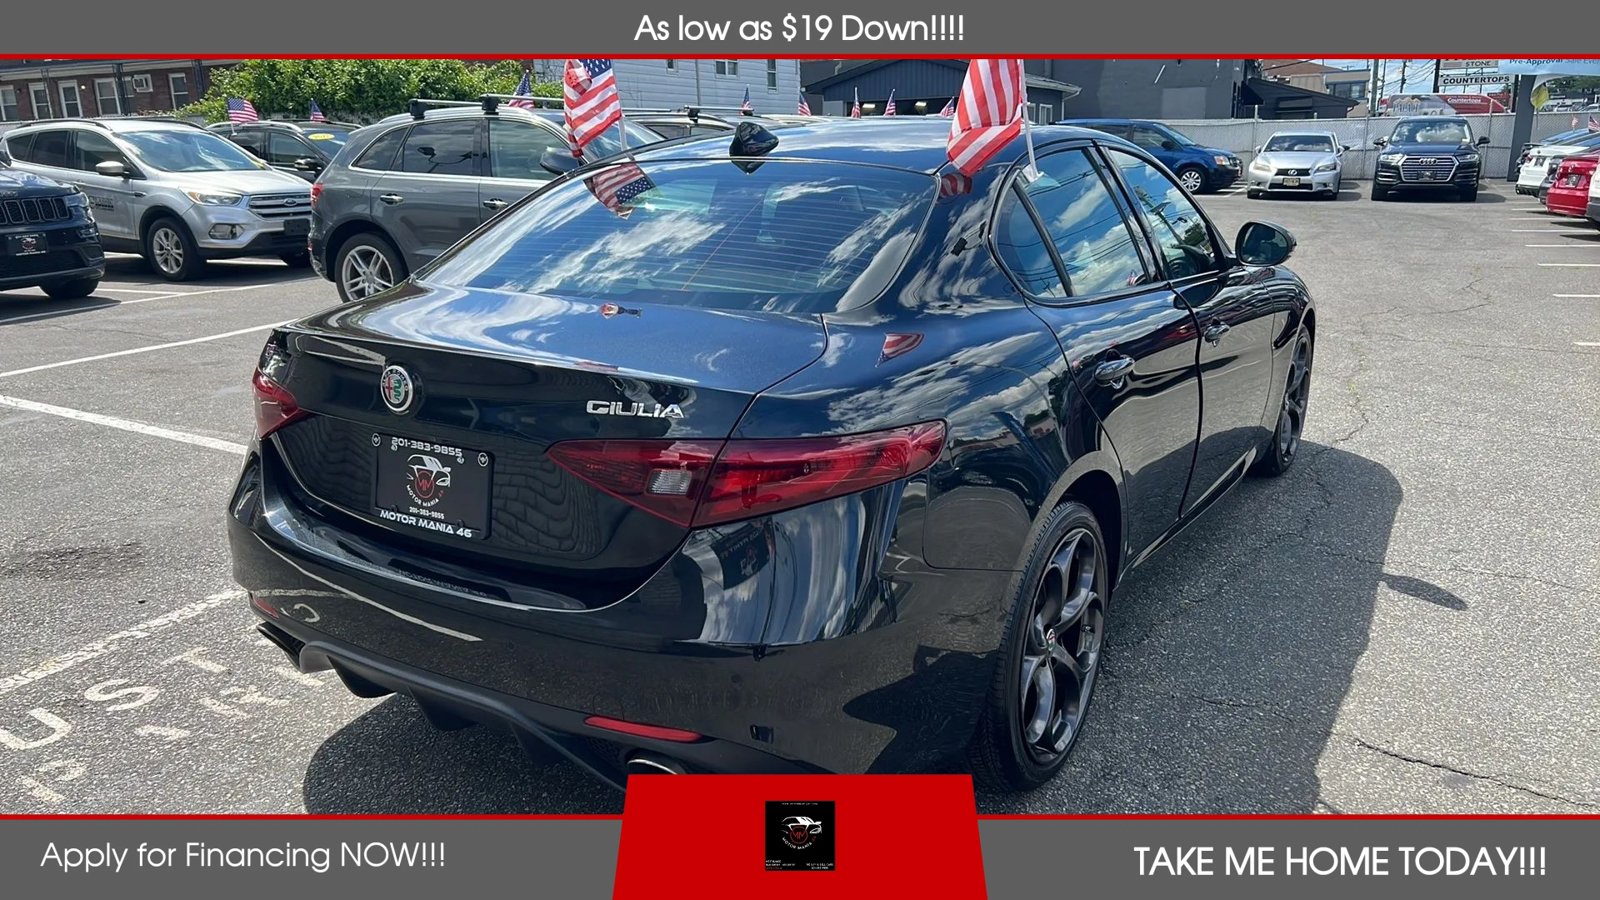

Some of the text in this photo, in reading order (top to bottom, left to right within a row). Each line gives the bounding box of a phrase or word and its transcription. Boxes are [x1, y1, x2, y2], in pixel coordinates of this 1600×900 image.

[1443, 76, 1510, 85] COUNTERTOPS
[586, 400, 684, 418] GIULIA
[391, 436, 463, 457] 201-383-9855
[380, 509, 472, 538] MOTOR MANIA 46
